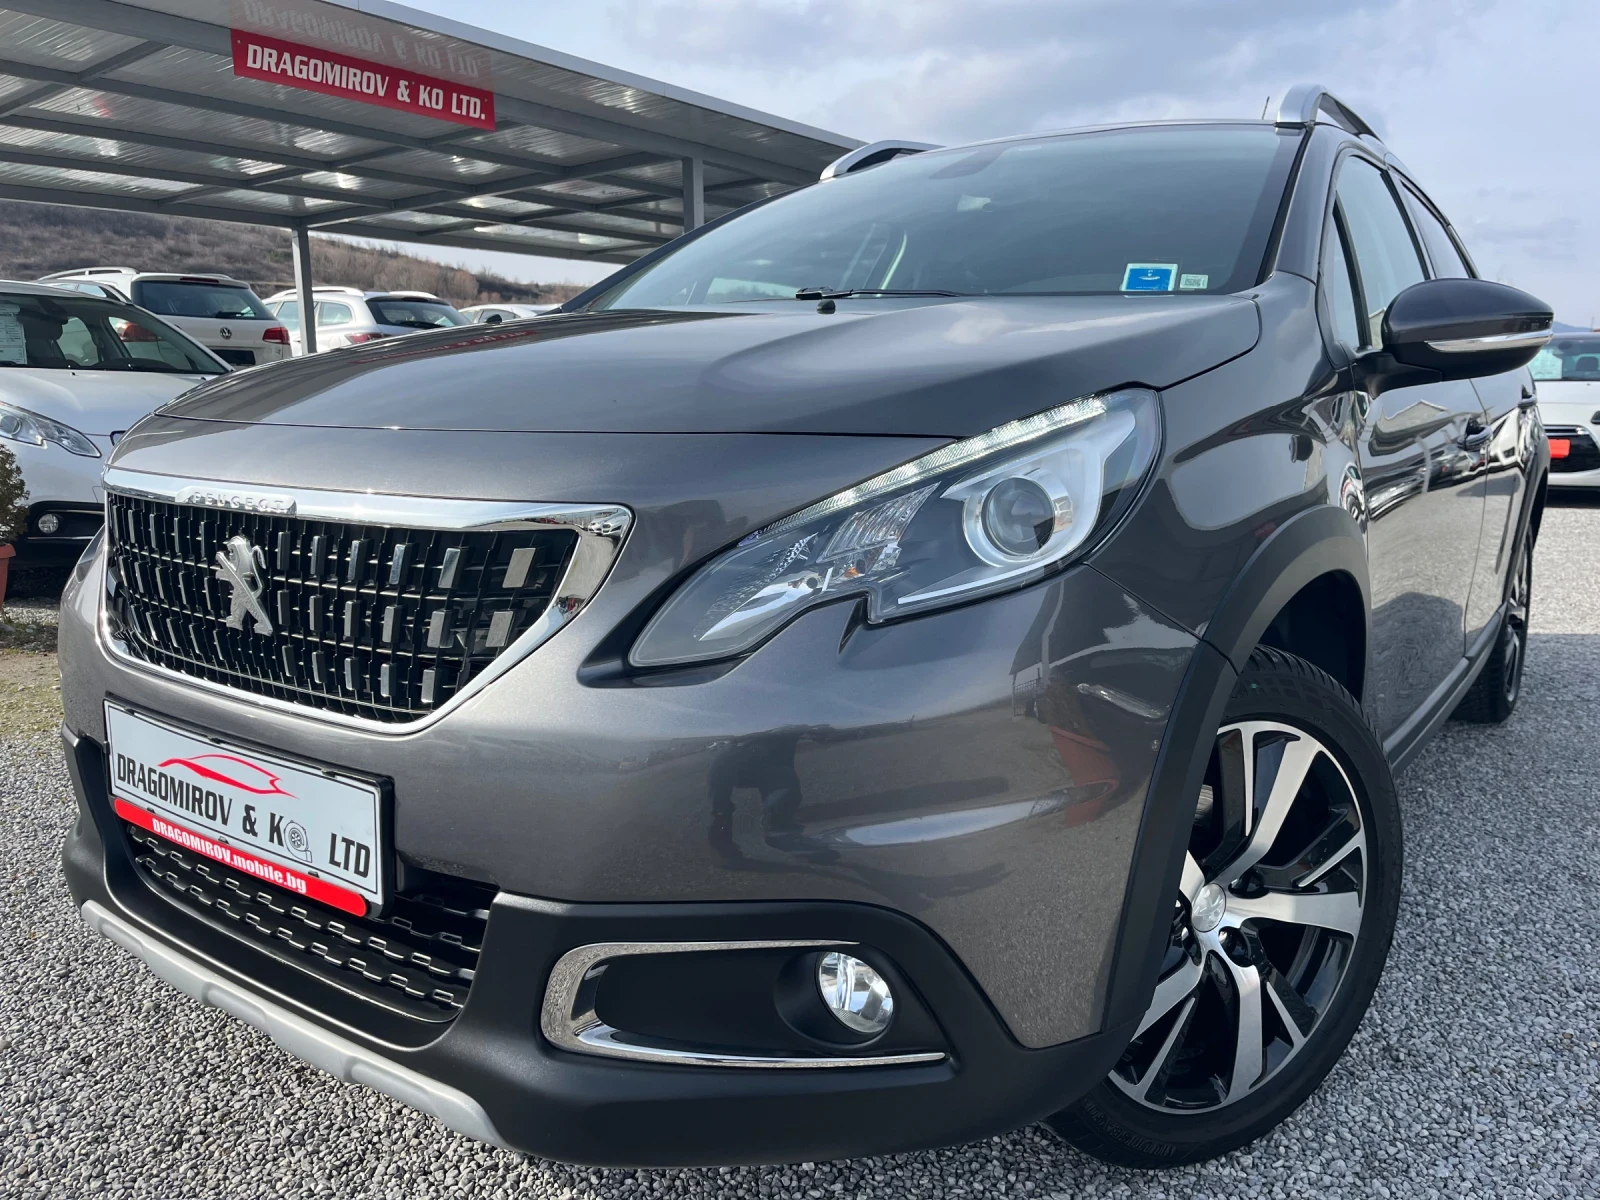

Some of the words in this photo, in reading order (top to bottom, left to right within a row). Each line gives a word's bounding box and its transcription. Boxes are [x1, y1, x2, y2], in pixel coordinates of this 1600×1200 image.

[247, 43, 389, 97] DRAGOMIROV
[397, 79, 411, 103] &
[418, 84, 444, 111] KO
[451, 92, 486, 120] LTD.
[117, 752, 233, 826] DRAGOMIROV
[242, 803, 259, 839] &
[328, 832, 371, 879] LTD
[151, 817, 307, 894] DRAGOMIROV.mobile.bg
